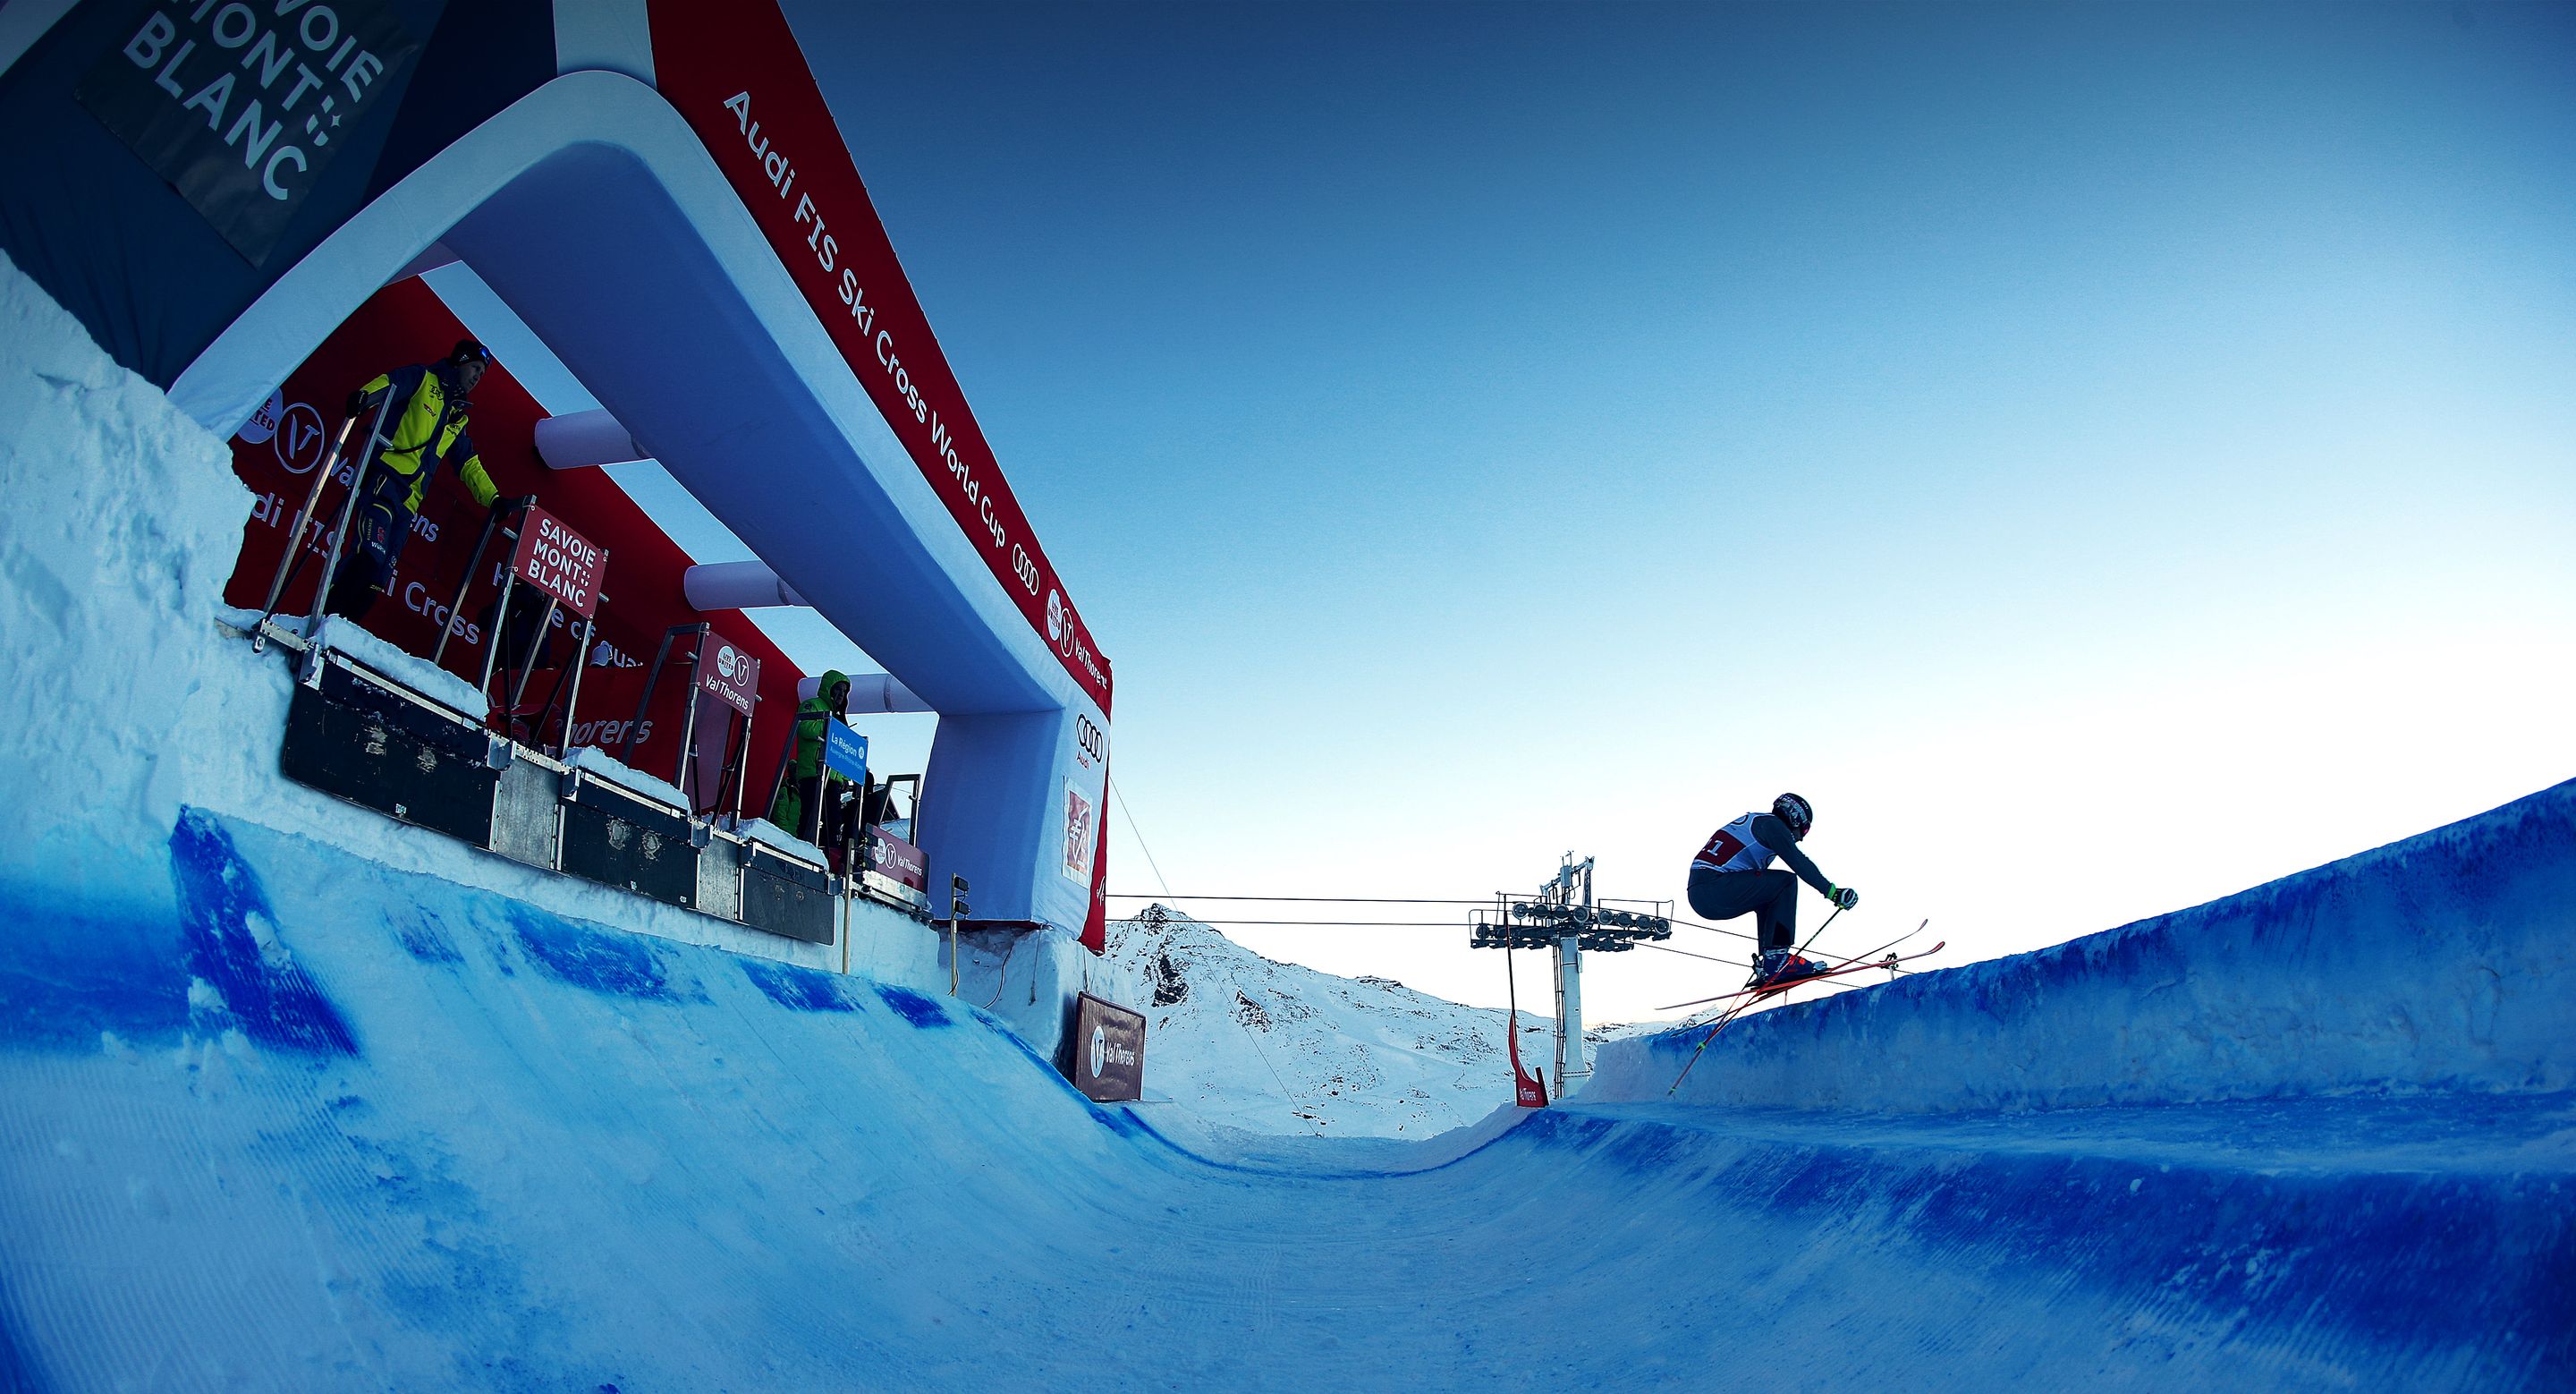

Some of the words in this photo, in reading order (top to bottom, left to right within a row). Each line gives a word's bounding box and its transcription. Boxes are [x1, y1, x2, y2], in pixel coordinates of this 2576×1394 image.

[123, 10, 308, 200] BLANC
[724, 91, 795, 200] Audi
[794, 192, 839, 272] FIS
[838, 268, 875, 336] Ski
[877, 330, 928, 423] Cross
[932, 411, 979, 506] World
[981, 496, 1005, 548] Cup
[533, 539, 582, 581] MONT
[539, 519, 597, 569] SAVOIE
[528, 558, 587, 608] BLANC
[404, 582, 480, 645] Cross
[1075, 636, 1085, 663] Val
[706, 674, 721, 692] Val
[719, 682, 750, 710] Thorens
[832, 733, 839, 745] La
[839, 737, 858, 757] Région
[1076, 751, 1090, 770] Audi
[897, 855, 905, 869] Val
[904, 856, 923, 876] Thorens
[1106, 1041, 1116, 1063] Val
